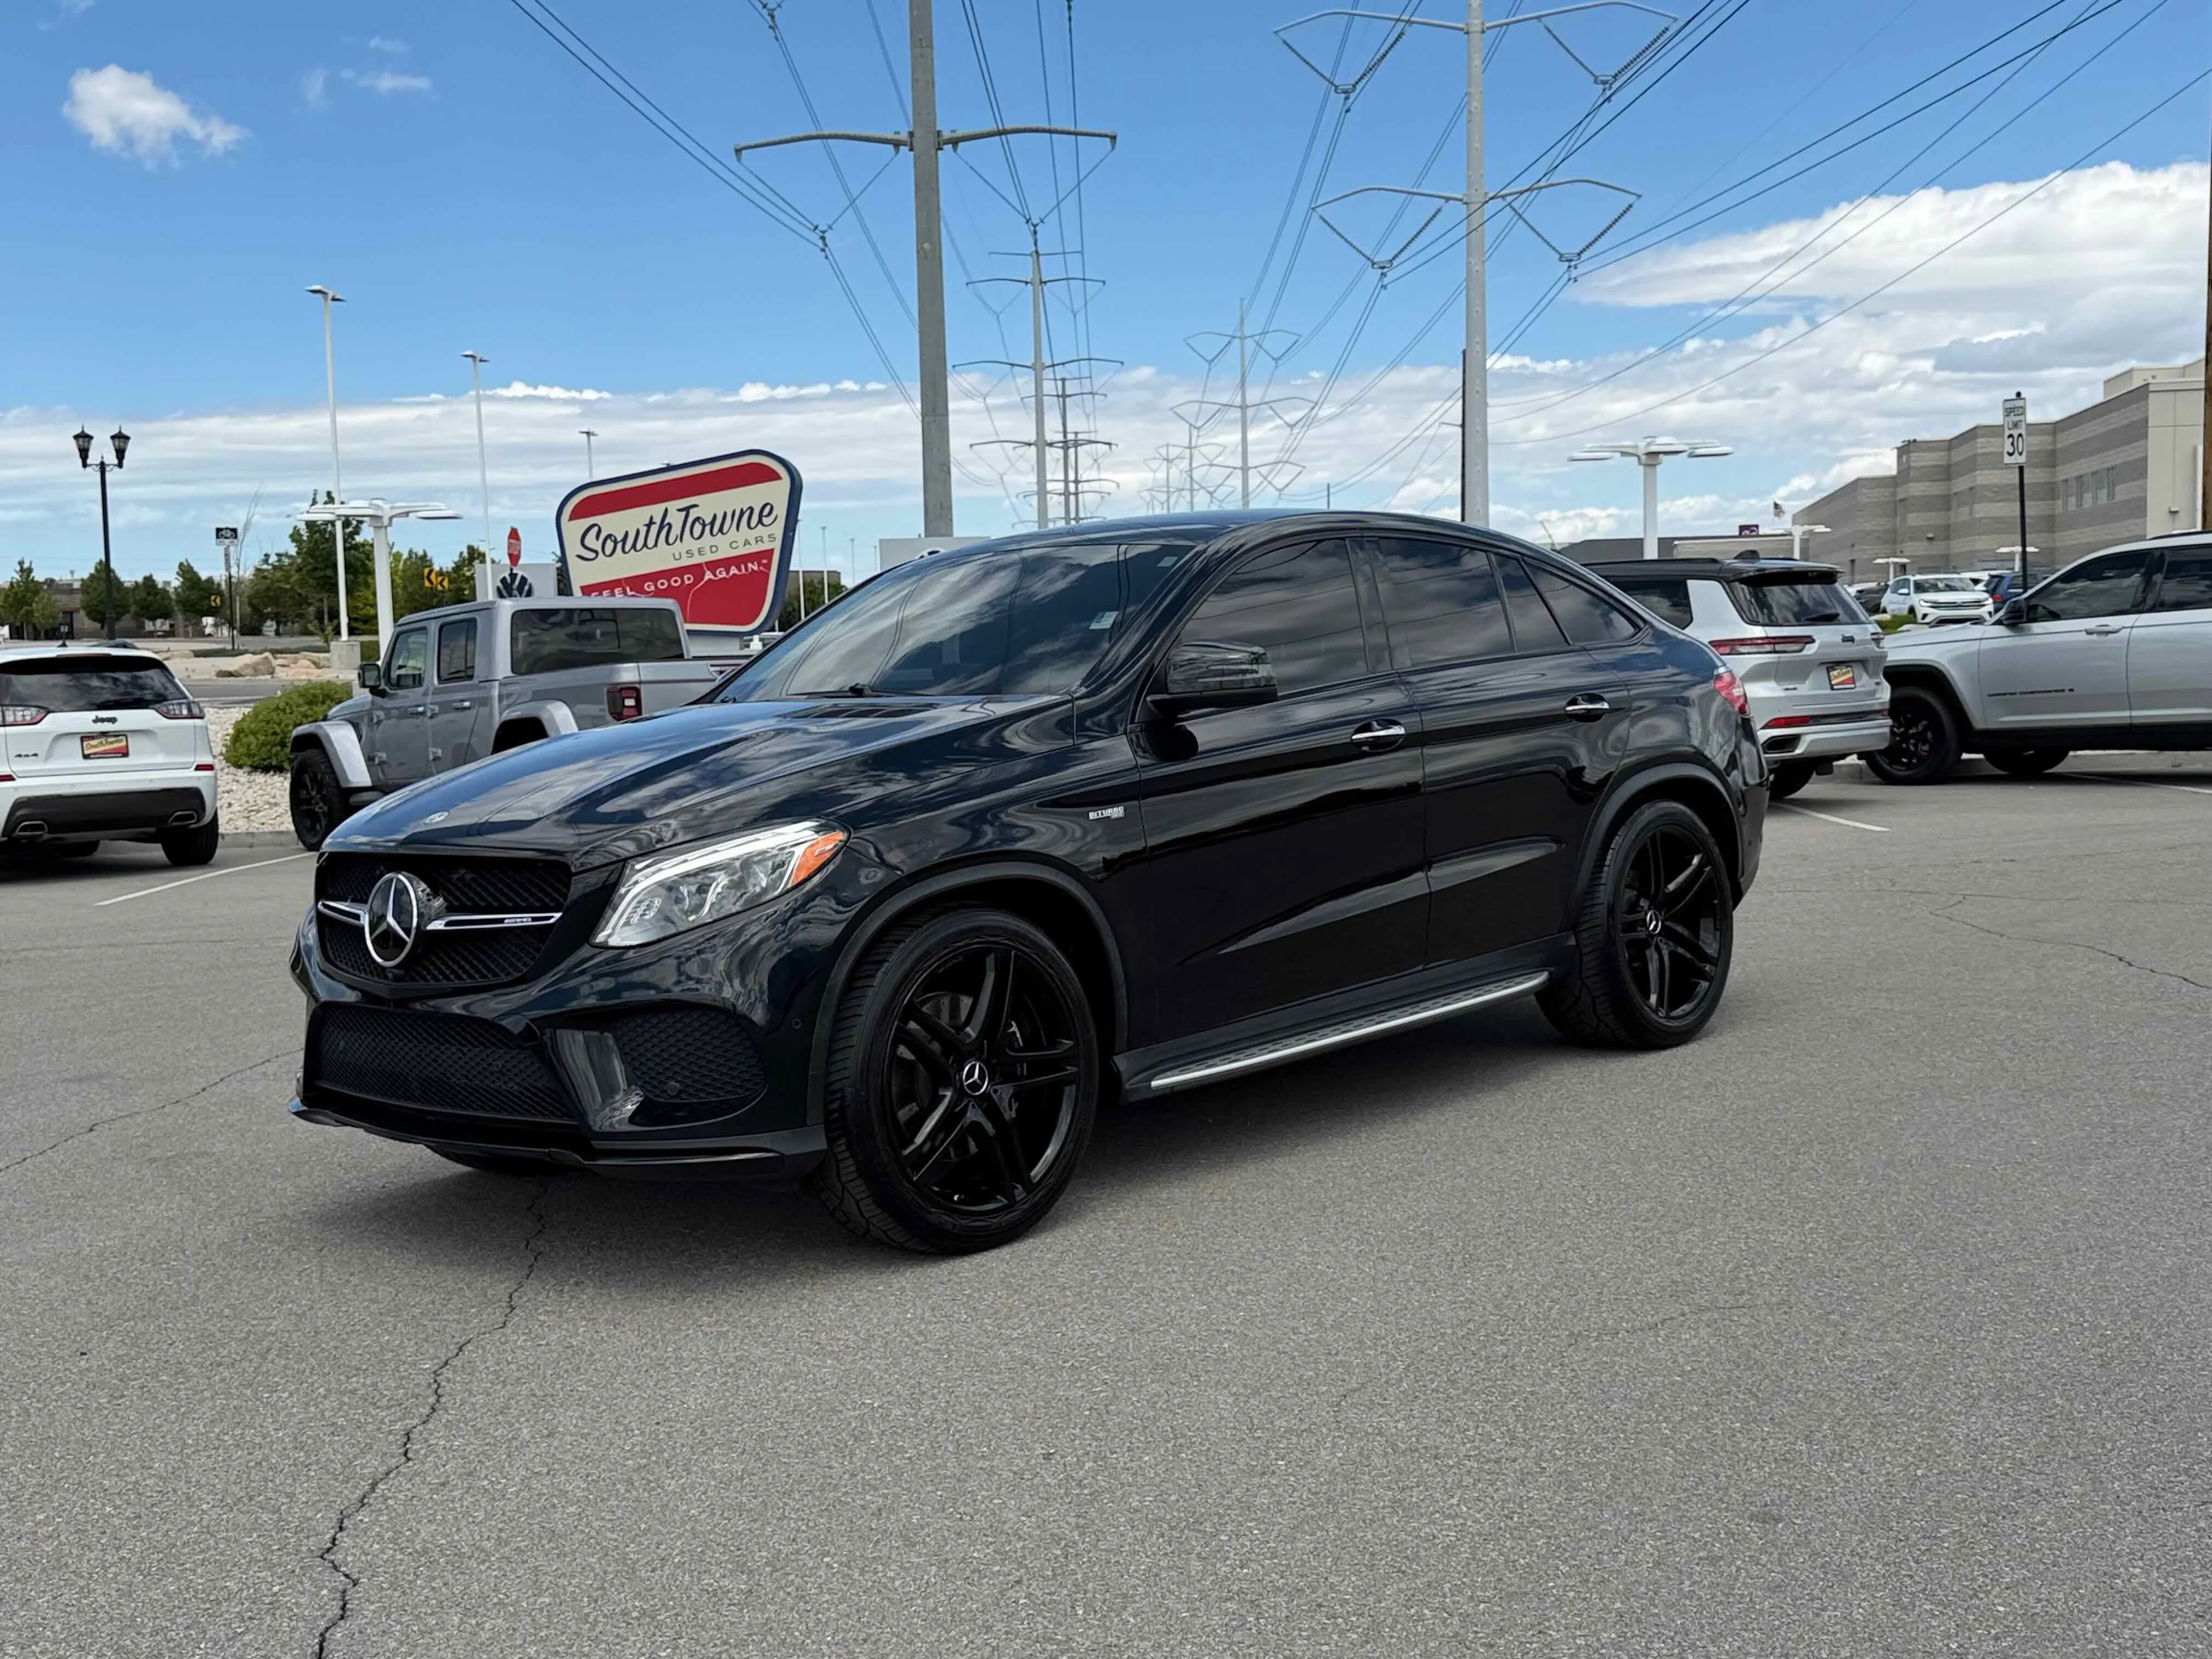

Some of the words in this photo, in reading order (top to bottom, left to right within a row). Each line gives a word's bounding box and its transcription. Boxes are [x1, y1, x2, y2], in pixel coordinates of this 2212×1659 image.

[2007, 433, 2024, 456] 30
[575, 501, 778, 562] SouthTowne
[673, 545, 719, 561] USED
[729, 533, 776, 550] CARS
[644, 574, 694, 591] GOOD
